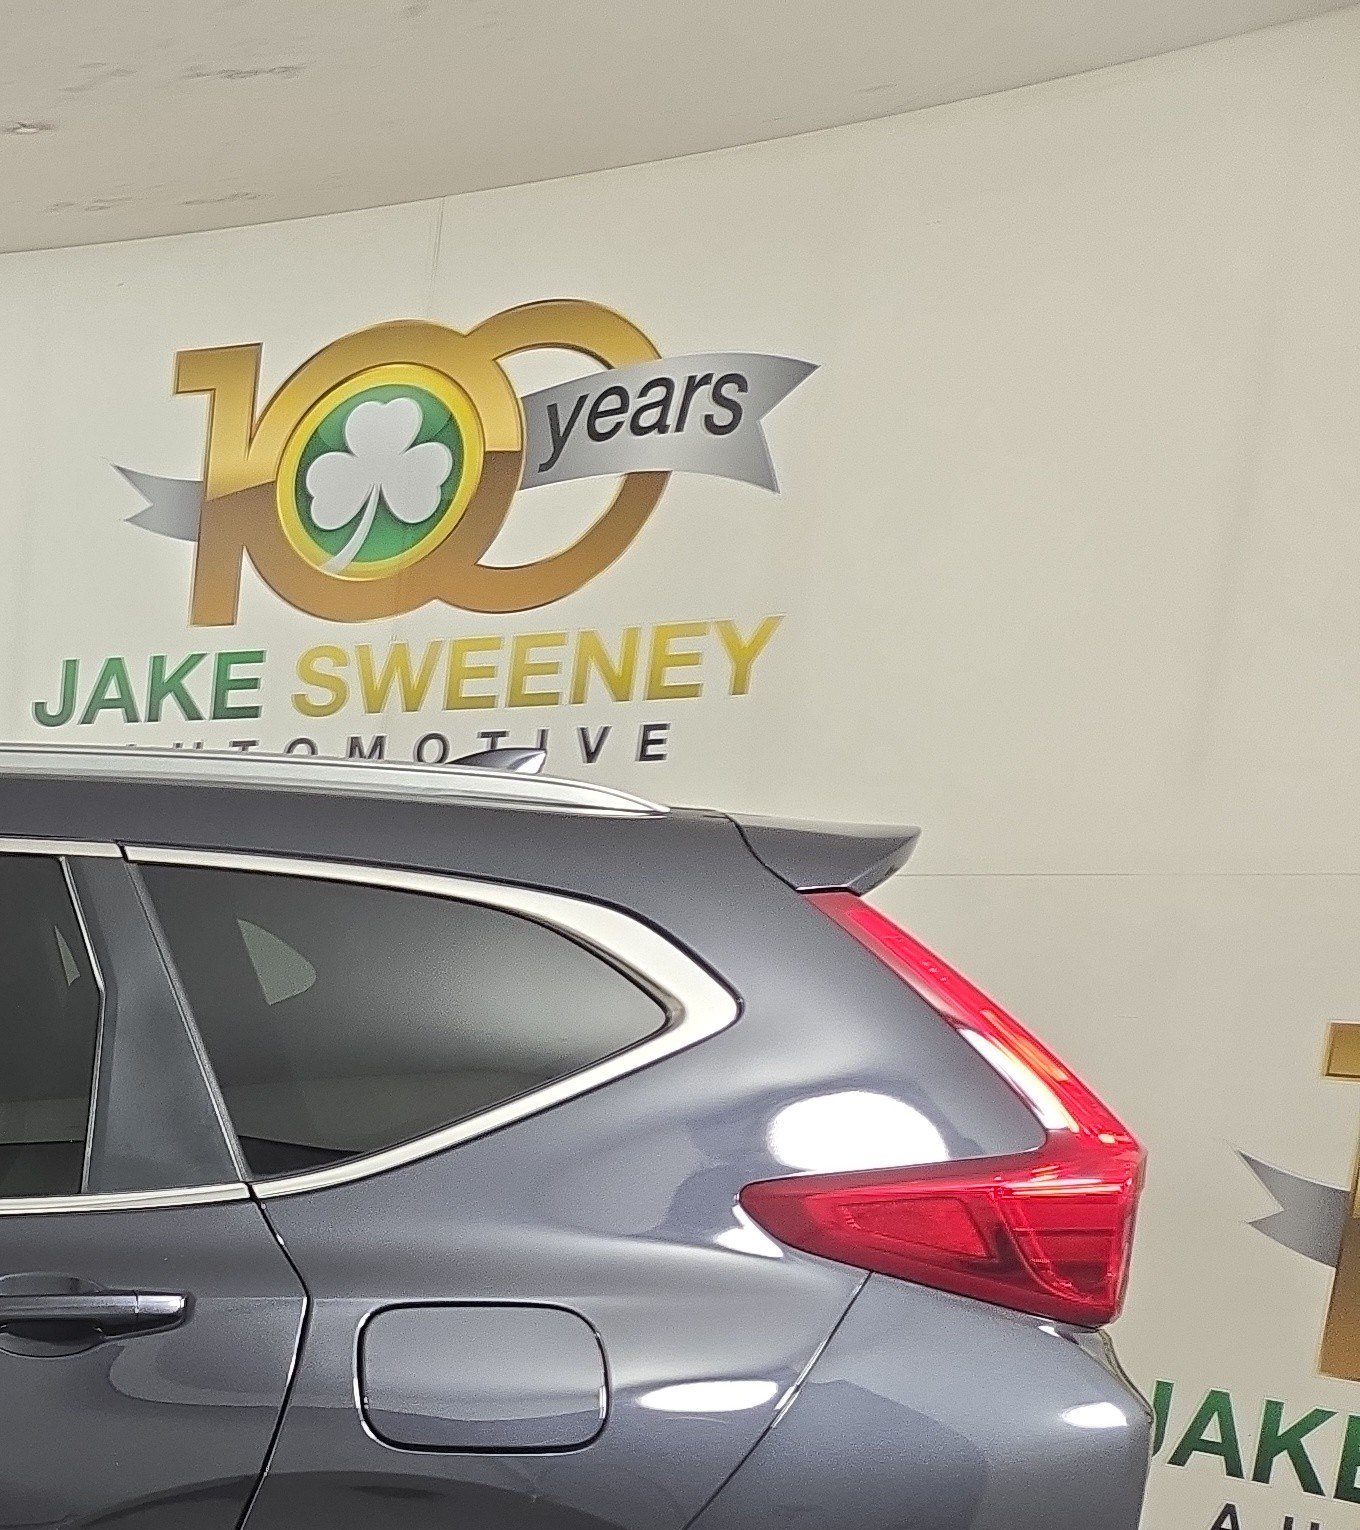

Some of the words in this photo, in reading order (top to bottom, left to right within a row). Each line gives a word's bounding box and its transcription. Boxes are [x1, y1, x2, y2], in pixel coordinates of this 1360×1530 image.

[174, 298, 671, 627] 100
[537, 371, 749, 472] years
[32, 648, 268, 728] JAKE
[291, 615, 783, 718] SWEENEY
[126, 722, 672, 764] MOTIVE
